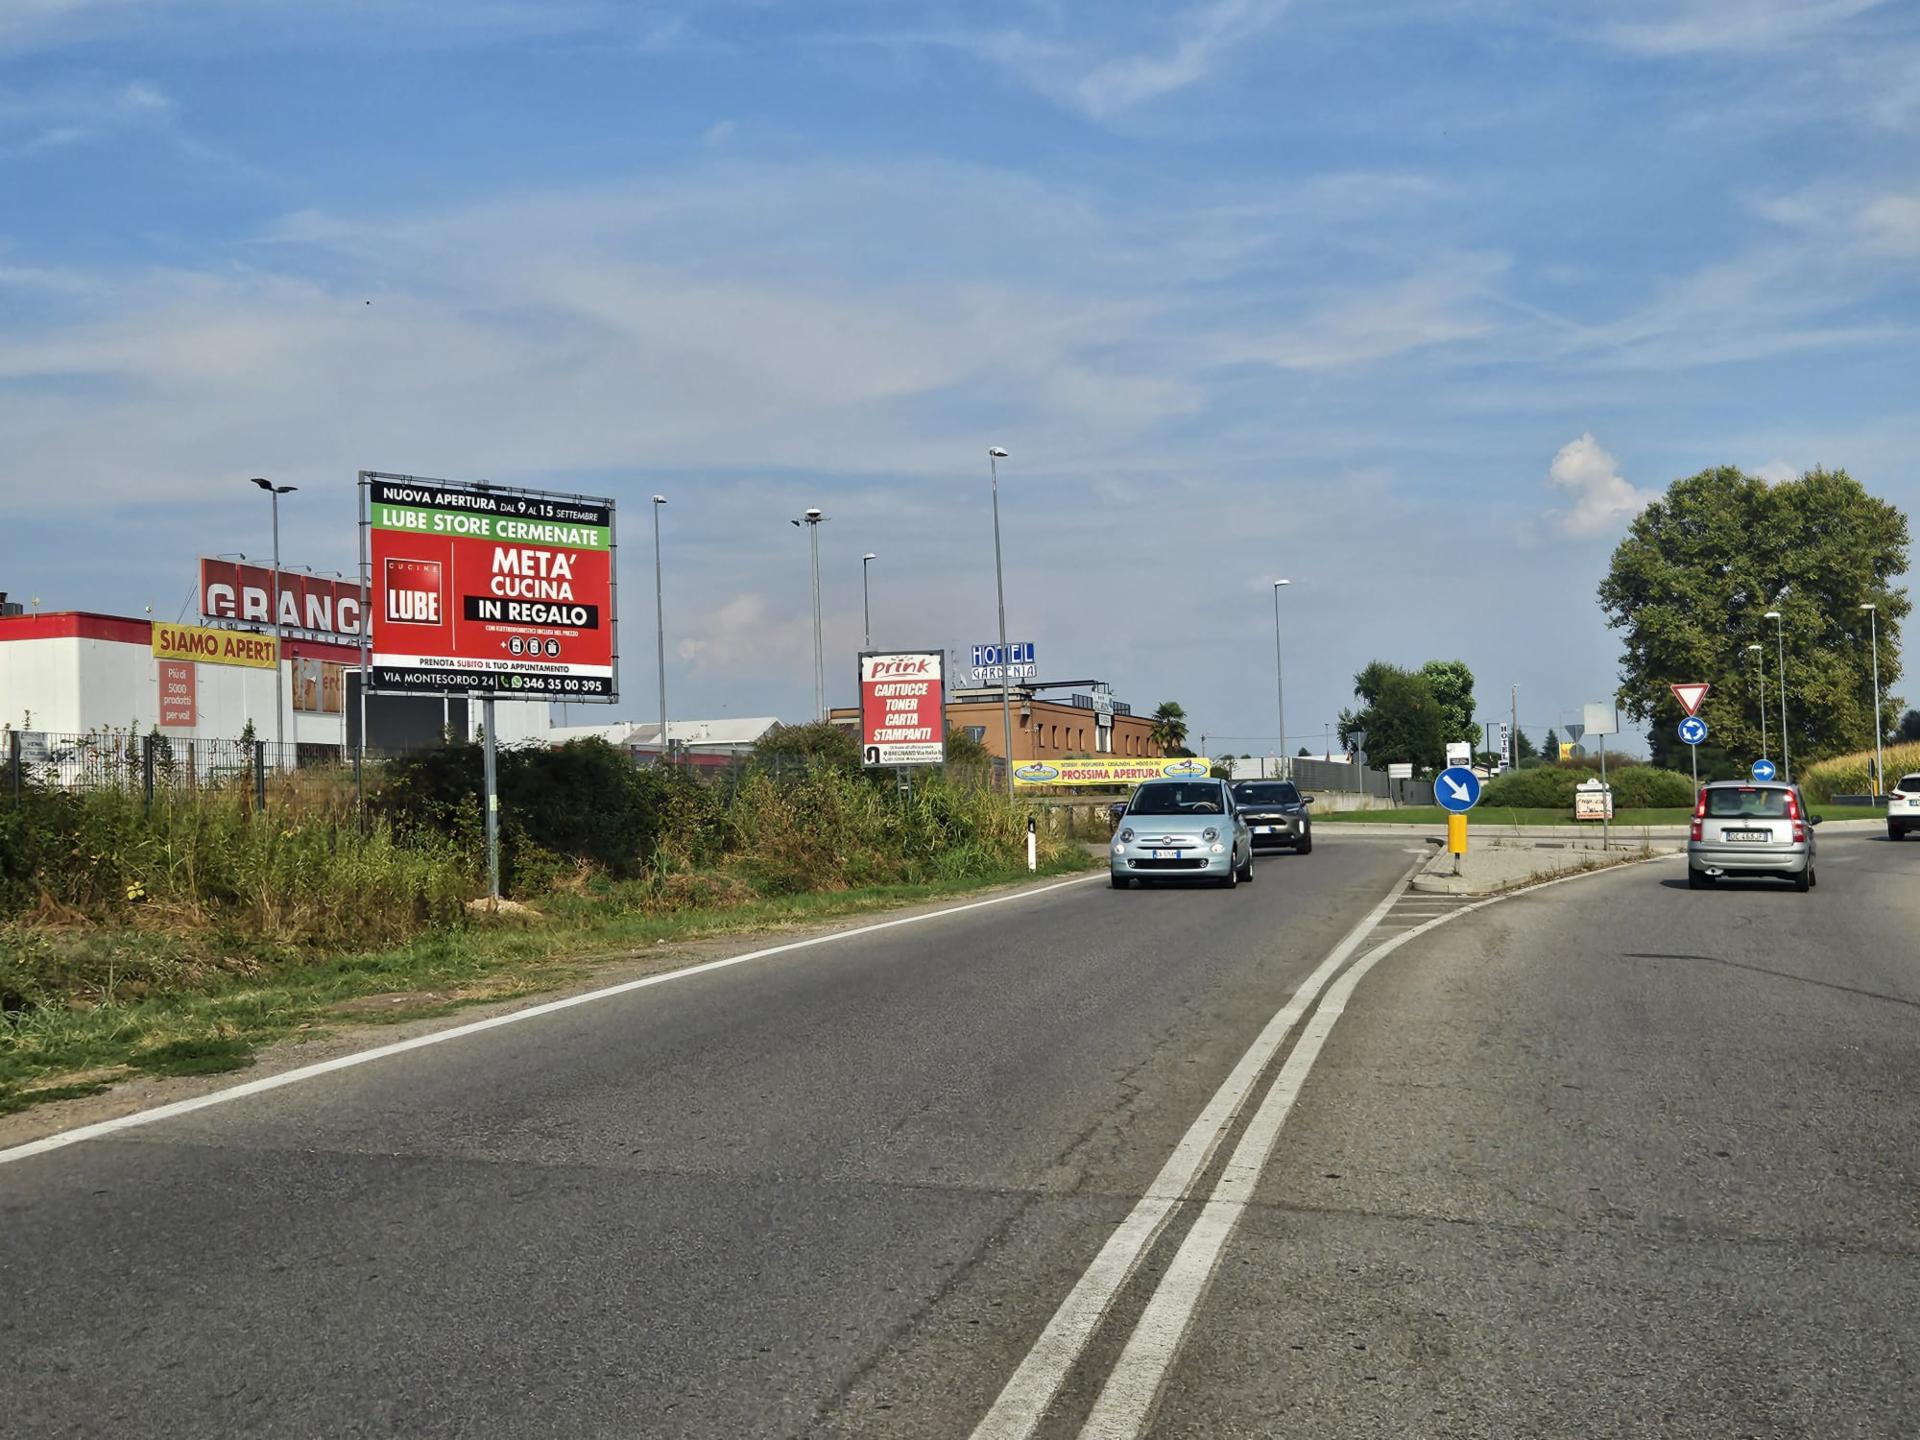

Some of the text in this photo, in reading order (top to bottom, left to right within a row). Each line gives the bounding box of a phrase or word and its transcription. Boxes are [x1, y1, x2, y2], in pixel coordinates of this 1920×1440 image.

[383, 487, 598, 522] NUOVA APERTURA DAL 9 AL 15 SETTEMBRE
[382, 508, 598, 546] LUBE STORE CERMENATE
[388, 562, 439, 573] CUCINE
[490, 576, 574, 602] CUCINA
[207, 583, 372, 637] GRANC
[389, 588, 438, 621] LUBE
[478, 599, 588, 626] IN REGALO
[160, 629, 276, 661] SIAMO APERTI
[973, 644, 1033, 665] HOEL
[419, 657, 455, 667] PRENOTA
[493, 662, 509, 670] TUO
[510, 663, 570, 673] APPUNTAMENTO
[871, 658, 931, 679] prink
[383, 672, 494, 687] VIA MONTESORDO 24
[523, 677, 602, 692] 346 35 00 395
[168, 683, 187, 694] 5000
[874, 683, 929, 697] CARTUCCE
[164, 696, 192, 706] prodotti
[885, 699, 918, 711] TONER
[885, 713, 918, 726] CARTA
[873, 728, 932, 741] STAMPANTI
[1500, 725, 1508, 760] HOTEL
[1061, 769, 1110, 780] PROSSIMA
[1113, 768, 1161, 778] APERTURA
